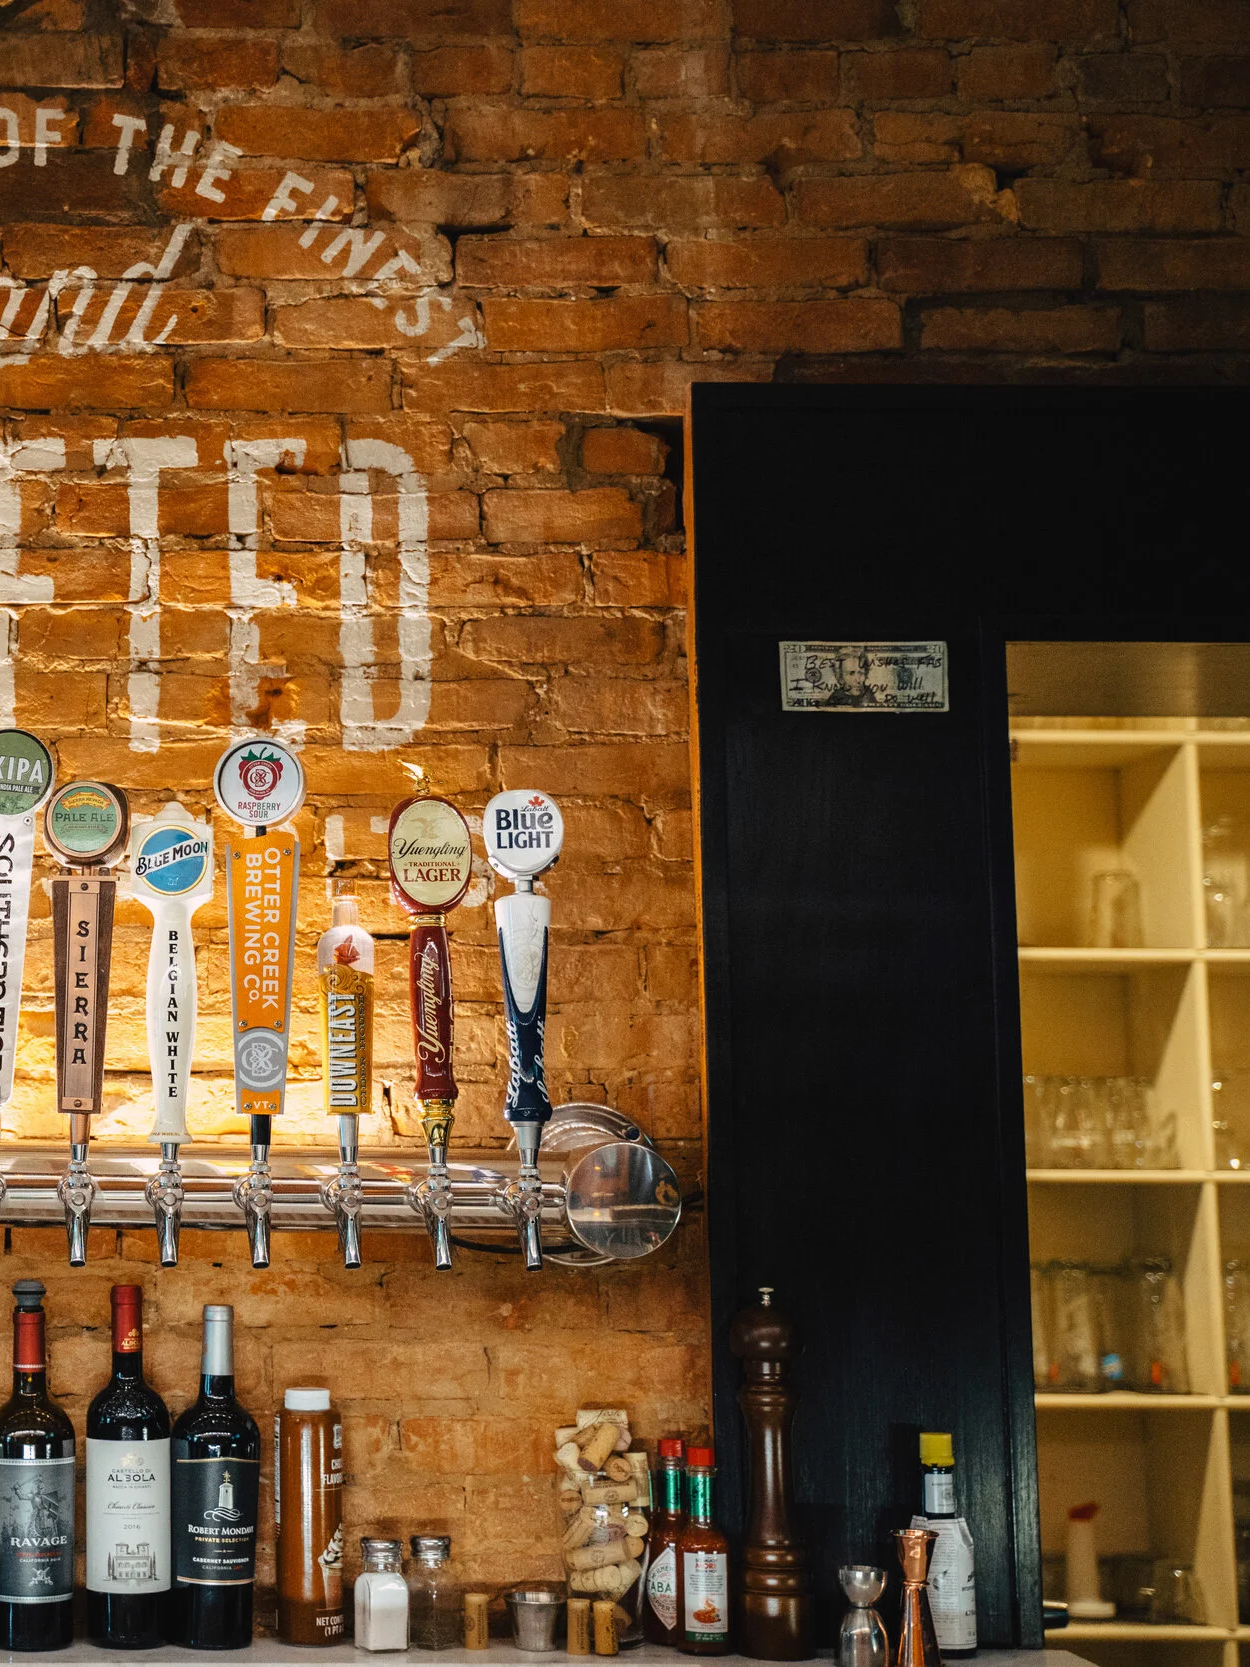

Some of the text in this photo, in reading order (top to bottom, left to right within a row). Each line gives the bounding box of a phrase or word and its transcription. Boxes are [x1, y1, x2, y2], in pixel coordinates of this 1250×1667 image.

[112, 113, 243, 203] THE
[262, 170, 485, 367] FINEST
[804, 655, 846, 670] BEST
[237, 801, 281, 810] RASPBERRY
[248, 809, 269, 818] SOUR
[55, 812, 114, 822] PALE ALE
[496, 808, 554, 831] Blue
[391, 837, 469, 860] Yuengling
[496, 831, 554, 849] LIGHT
[171, 841, 208, 861] MOON
[403, 868, 462, 883] LAGER
[243, 853, 262, 965] BREWING
[261, 847, 281, 1009] OTTER CREEK
[71, 920, 90, 1065] SIERRA
[165, 930, 180, 1098] BELGIAN WHITE
[414, 952, 446, 1064] Yuengling
[327, 991, 358, 1107] DOWNEAST
[253, 1101, 269, 1109] VT
[187, 1524, 220, 1535] ROBERT
[10, 1535, 68, 1548] RAVAGE
[192, 1556, 222, 1564] CABERNET
[316, 1616, 329, 1626] NET
